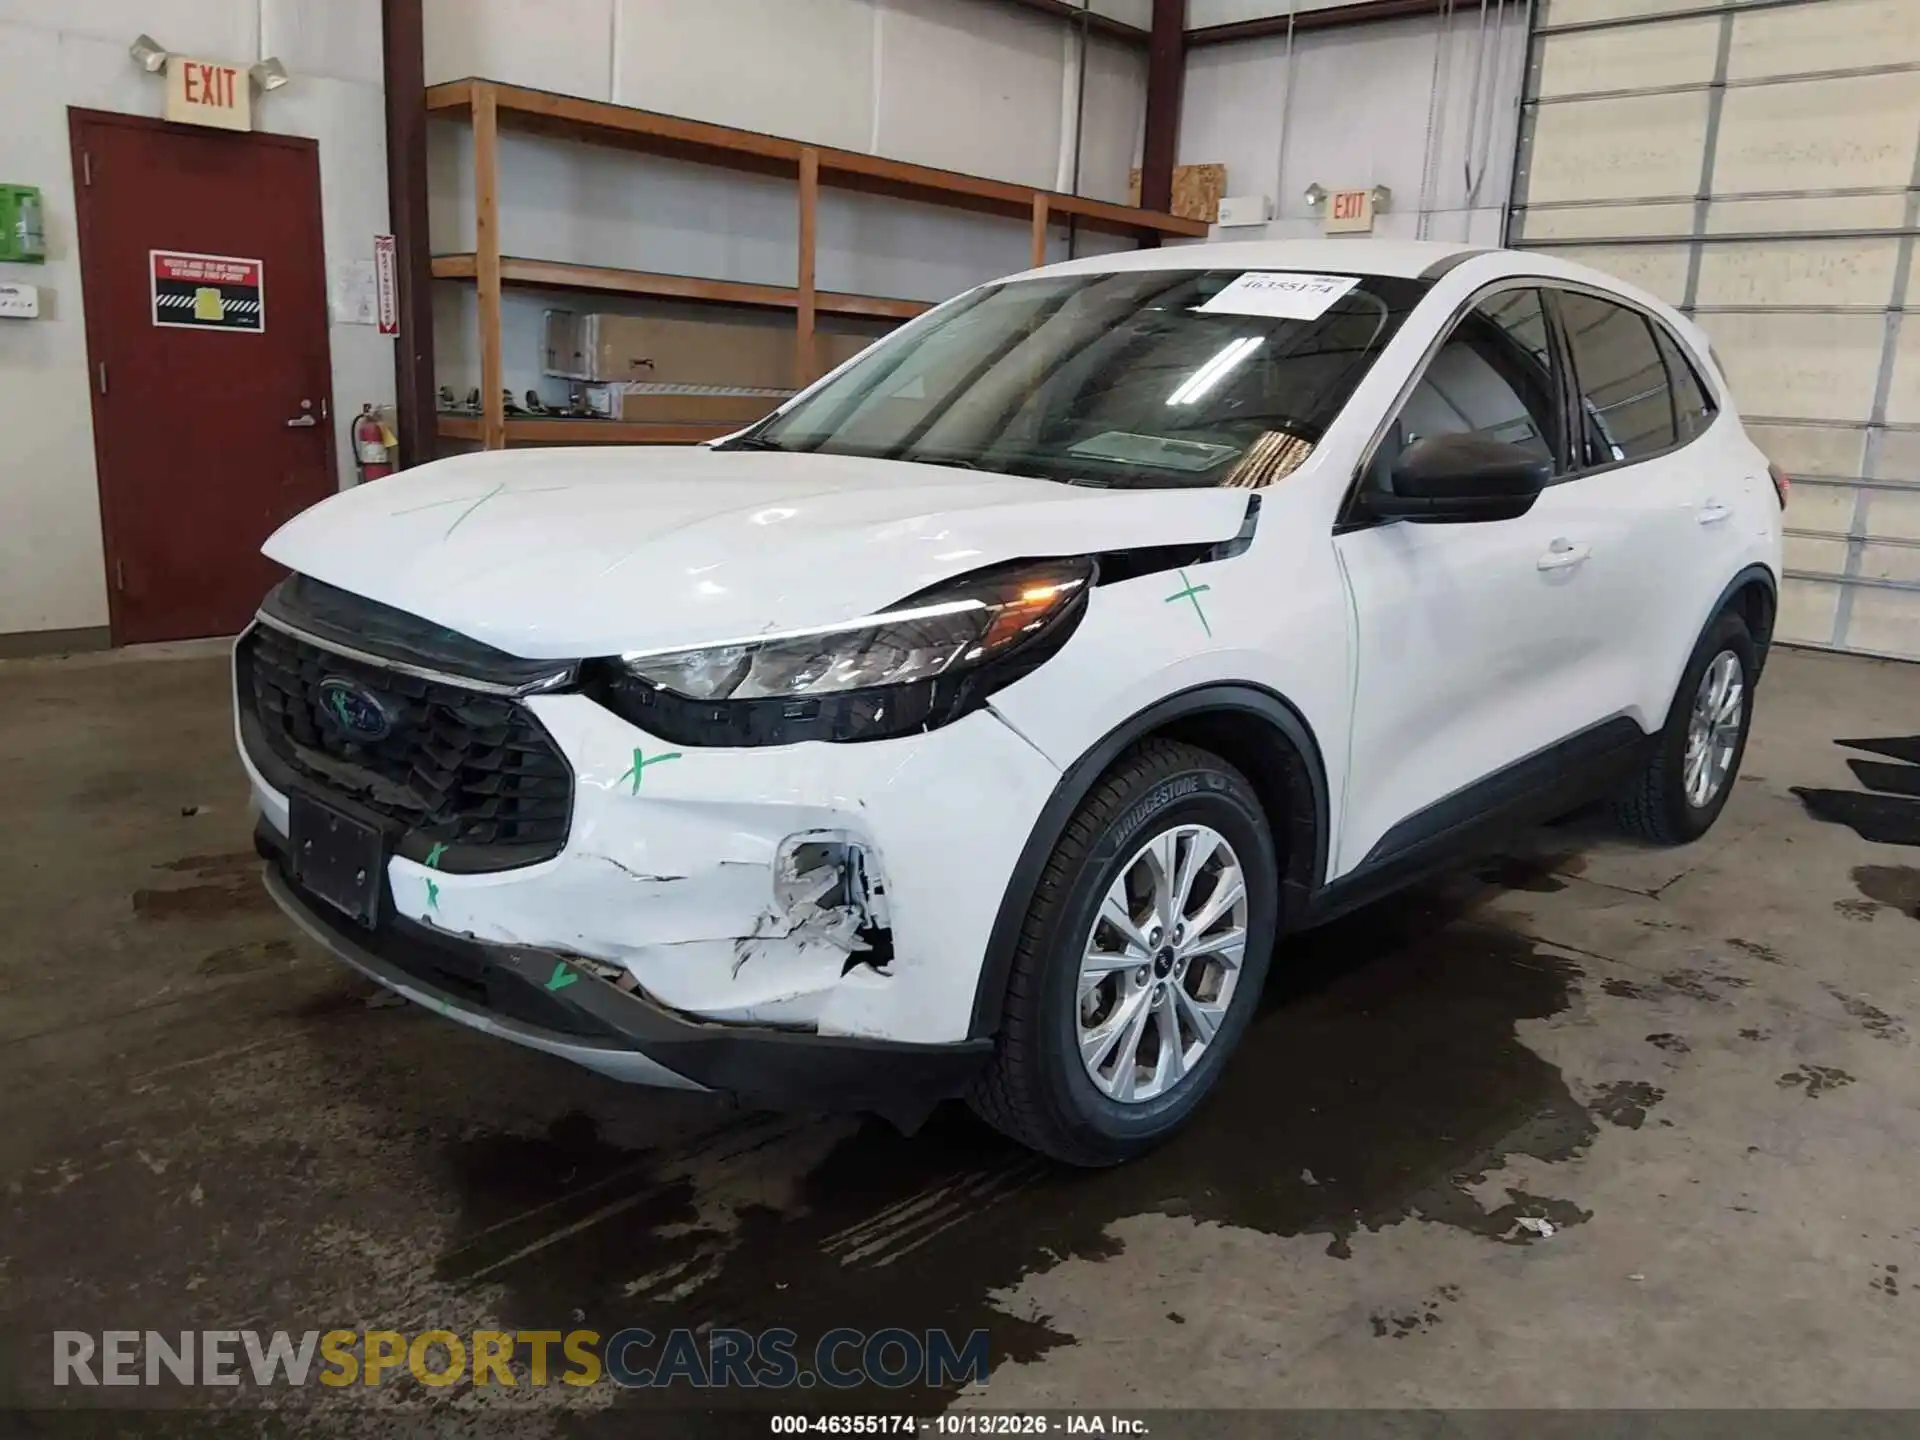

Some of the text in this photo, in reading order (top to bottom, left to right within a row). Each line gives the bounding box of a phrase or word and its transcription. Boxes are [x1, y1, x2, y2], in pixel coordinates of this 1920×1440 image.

[183, 62, 237, 109] EXIT
[1333, 192, 1365, 219] EXIT
[1114, 776, 1199, 848] BRIDGESTONE
